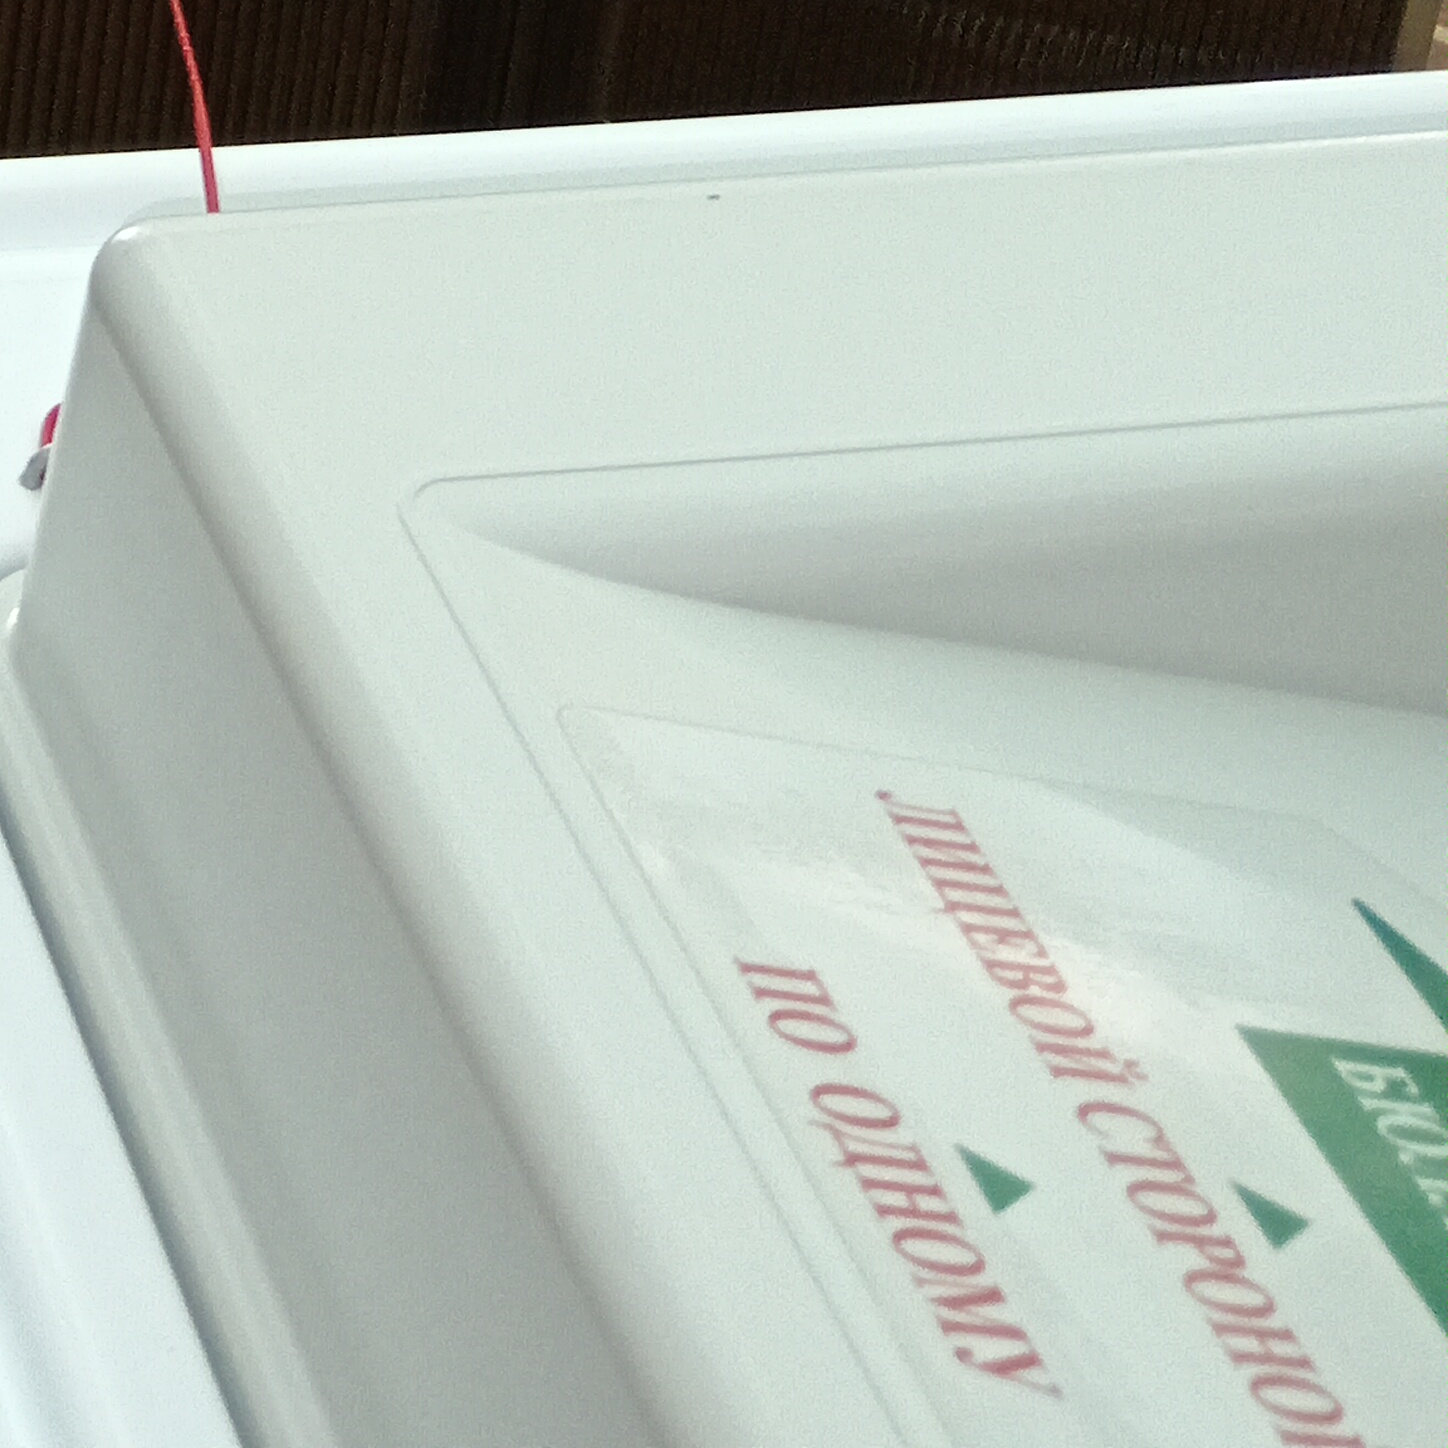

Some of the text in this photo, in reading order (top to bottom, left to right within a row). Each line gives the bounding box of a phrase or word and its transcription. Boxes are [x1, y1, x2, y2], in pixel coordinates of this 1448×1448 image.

[733, 958, 1066, 1399] ПО ОДНОМУ
[876, 790, 1366, 1448] ЛИЦЕВОЙ СТОРОНО
